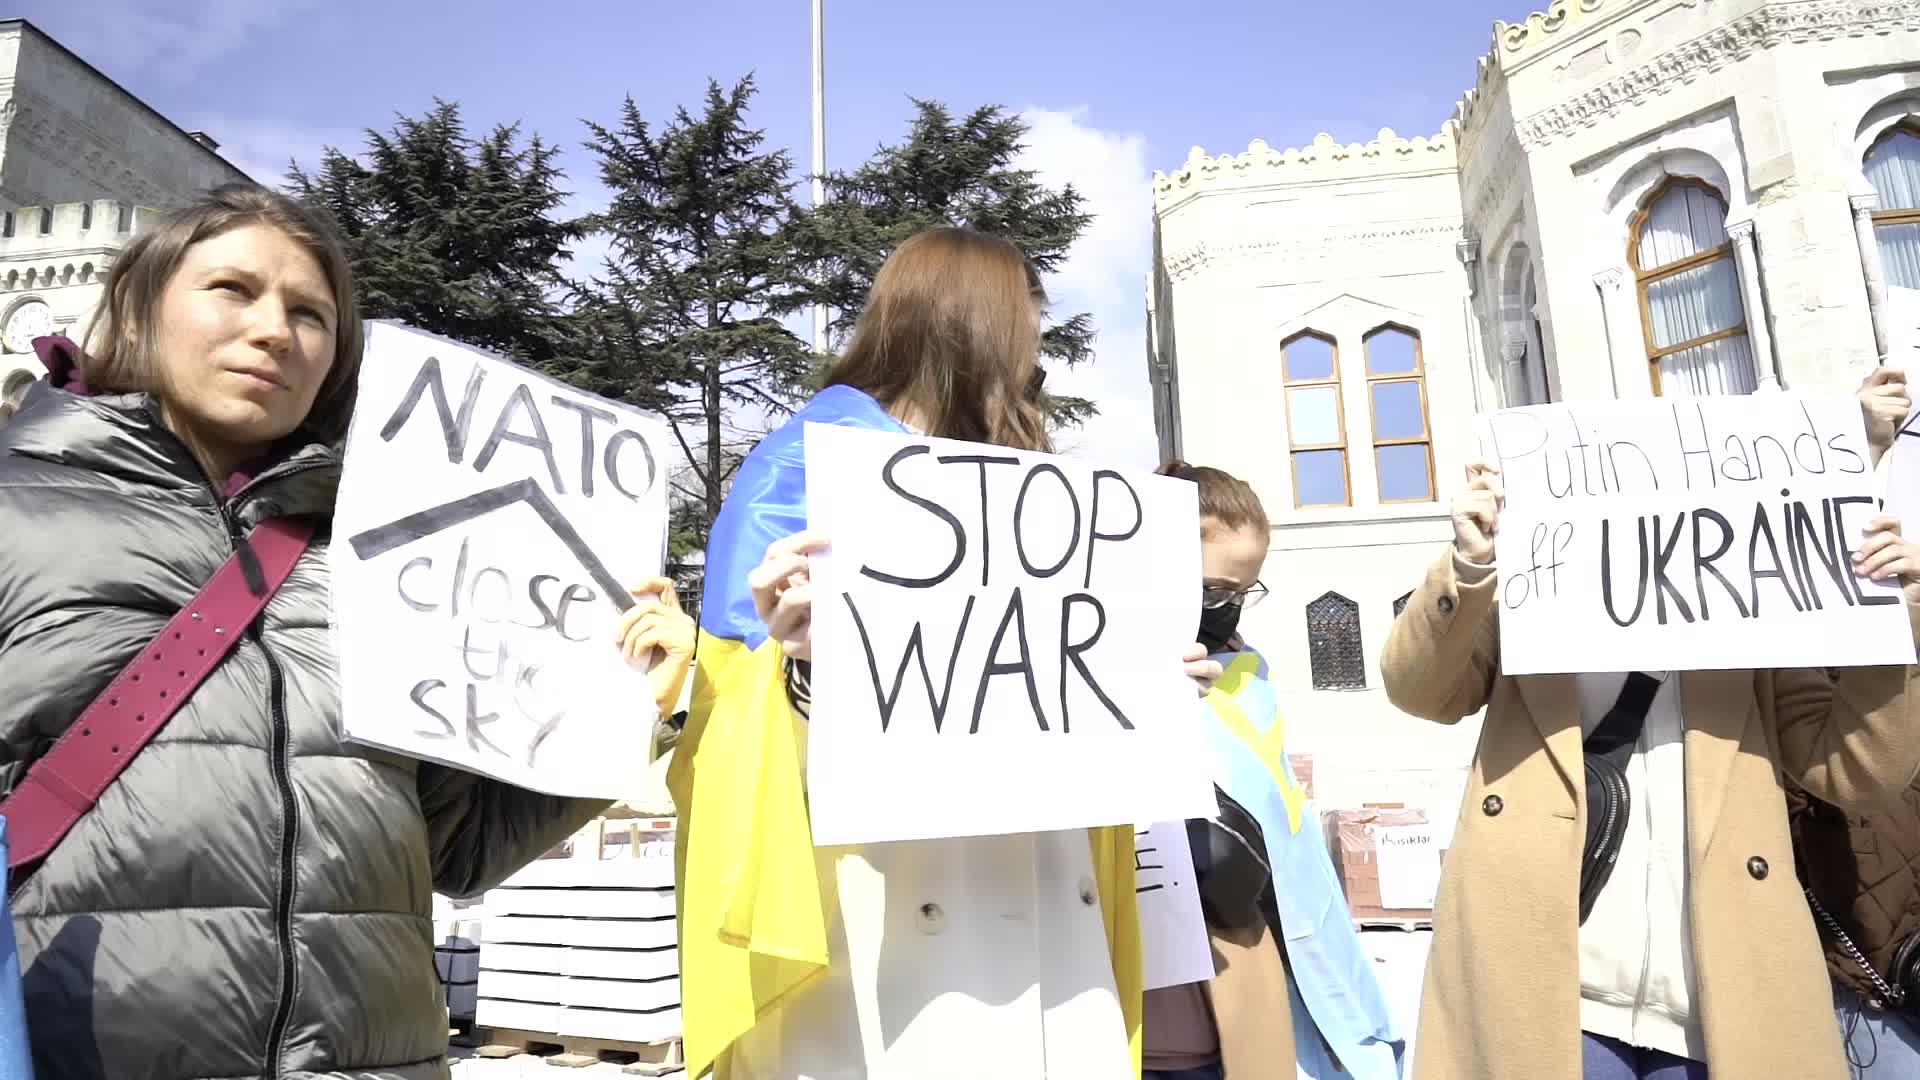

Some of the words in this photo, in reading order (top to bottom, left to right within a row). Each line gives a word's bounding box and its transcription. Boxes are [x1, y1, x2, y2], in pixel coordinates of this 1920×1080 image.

[380, 356, 656, 502] NATO
[1488, 409, 1659, 499] Putin
[1672, 399, 1866, 491] Hands
[859, 444, 1143, 589] STOP
[1504, 521, 1574, 609] off
[842, 586, 1136, 734] WAR
